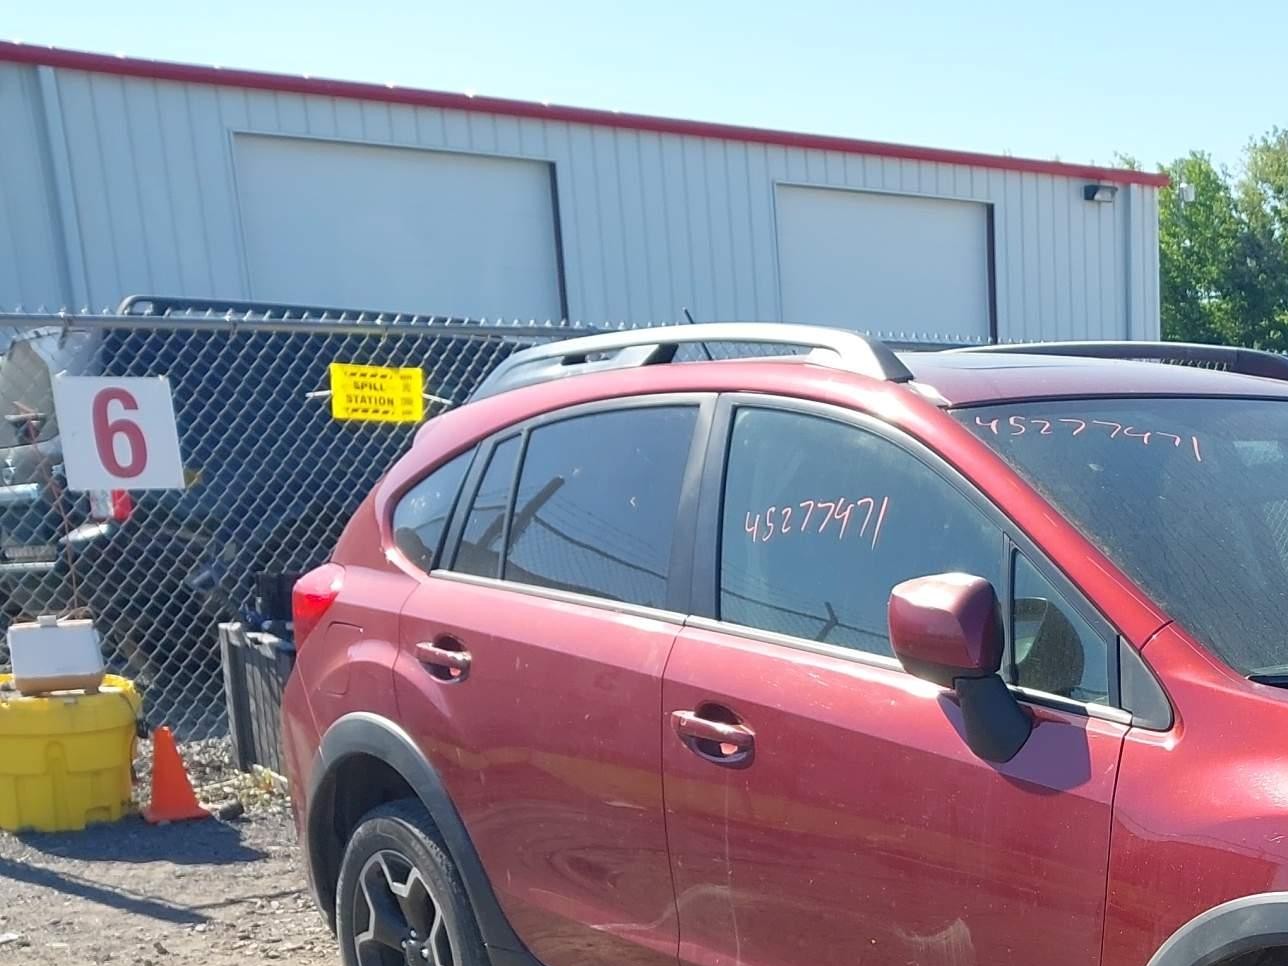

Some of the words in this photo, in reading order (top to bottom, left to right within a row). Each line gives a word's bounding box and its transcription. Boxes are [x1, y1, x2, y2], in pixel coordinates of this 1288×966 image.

[345, 393, 395, 406] STATION
[353, 381, 384, 392] SPILL
[92, 386, 148, 479] 6
[975, 415, 1201, 462] 45277471
[744, 496, 889, 550] 45277471
